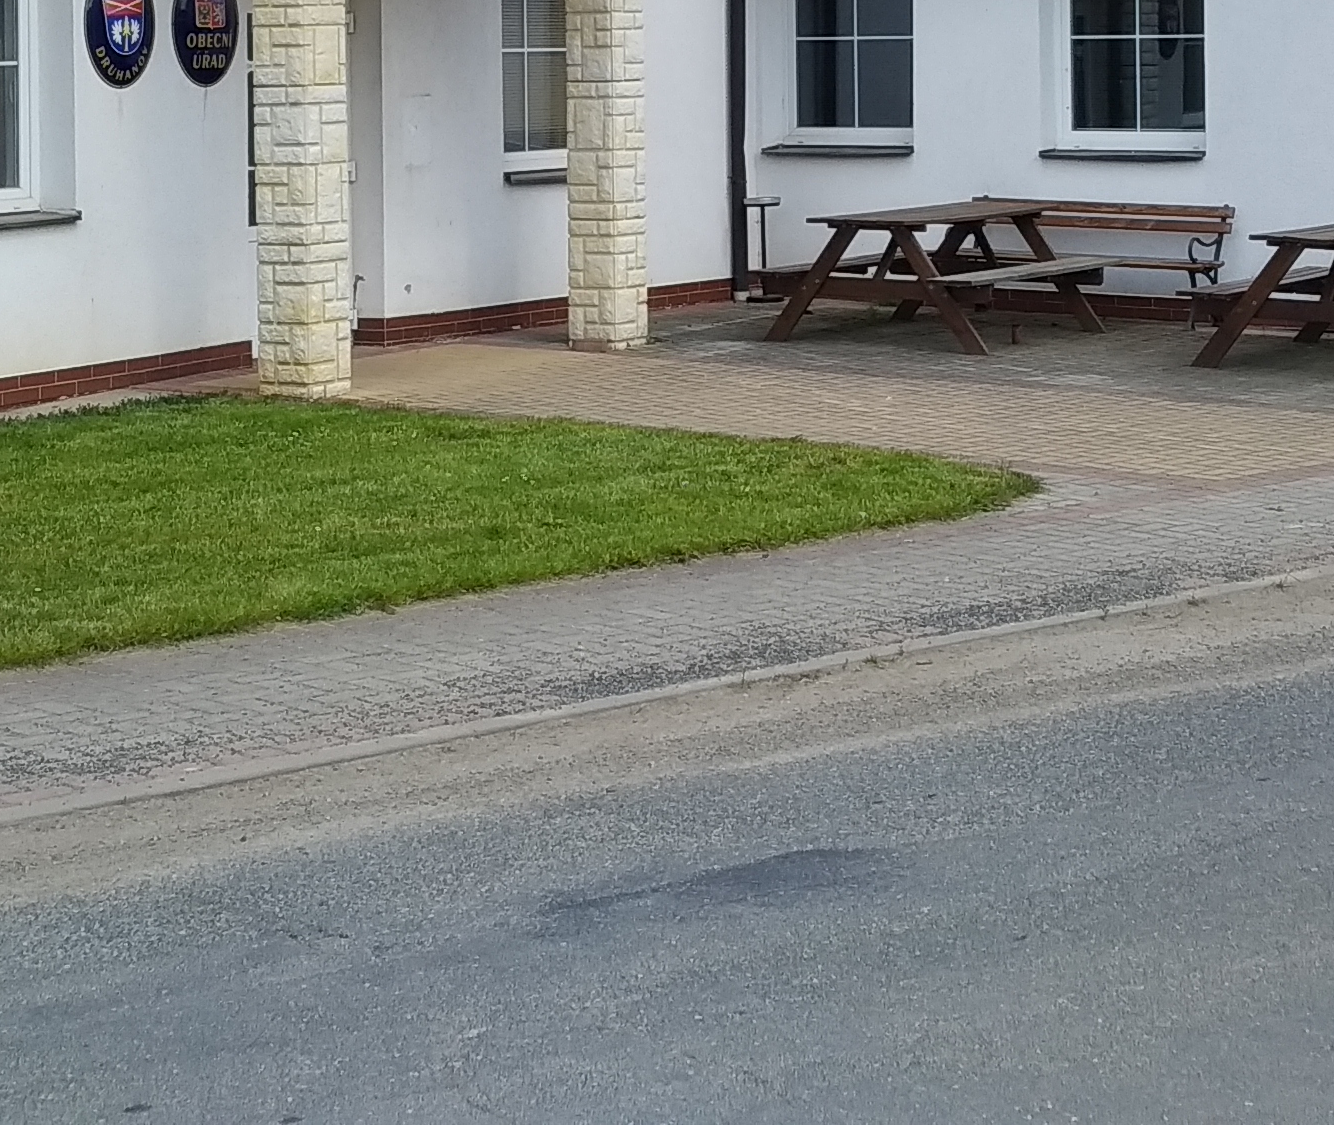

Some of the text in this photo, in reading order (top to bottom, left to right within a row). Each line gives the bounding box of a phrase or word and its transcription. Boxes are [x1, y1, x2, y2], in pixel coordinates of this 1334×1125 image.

[186, 31, 233, 49] OBECNÍ
[94, 45, 149, 82] DRUHANOV
[192, 50, 227, 70] ÚŘAD
